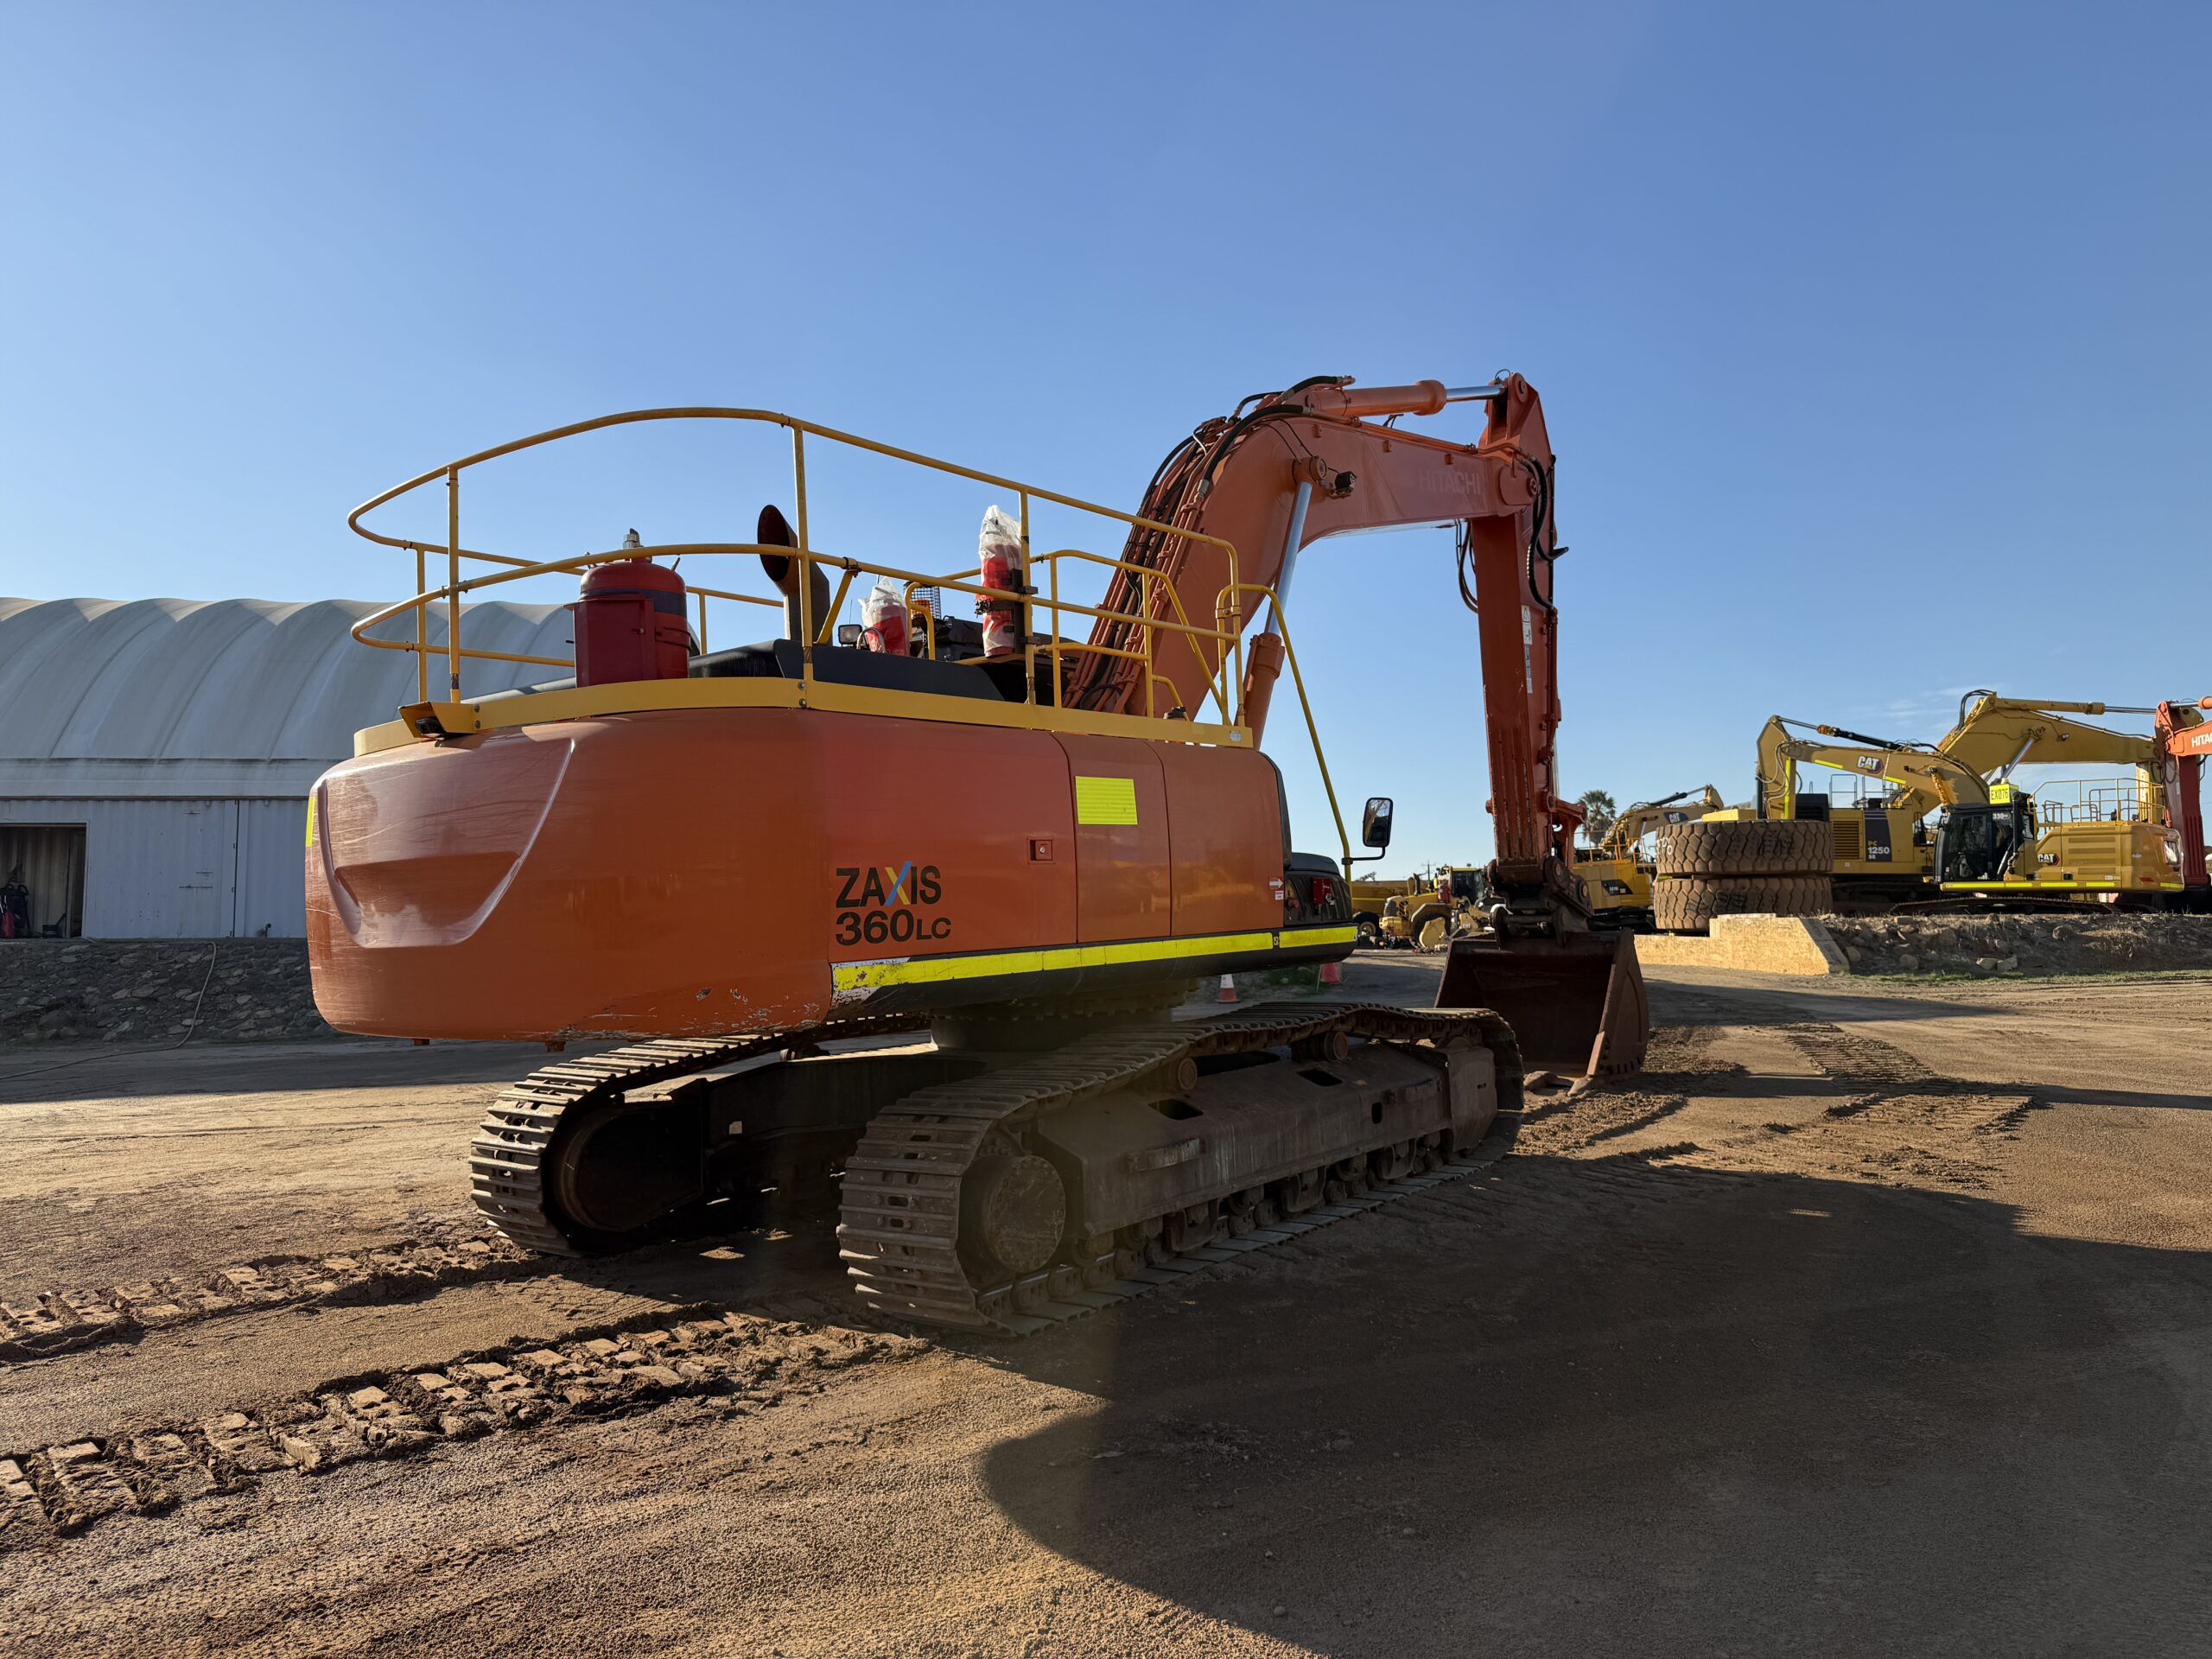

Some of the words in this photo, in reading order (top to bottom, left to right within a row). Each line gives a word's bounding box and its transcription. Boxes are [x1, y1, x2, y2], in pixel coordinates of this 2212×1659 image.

[1419, 469, 1481, 495] HITACHI
[1857, 755, 1880, 771] CAT
[1669, 812, 1680, 823] CAT
[1866, 846, 1891, 855] 1250
[2037, 853, 2055, 863] CAT
[836, 861, 942, 908] ZAXIS
[836, 909, 951, 946] 360LC
